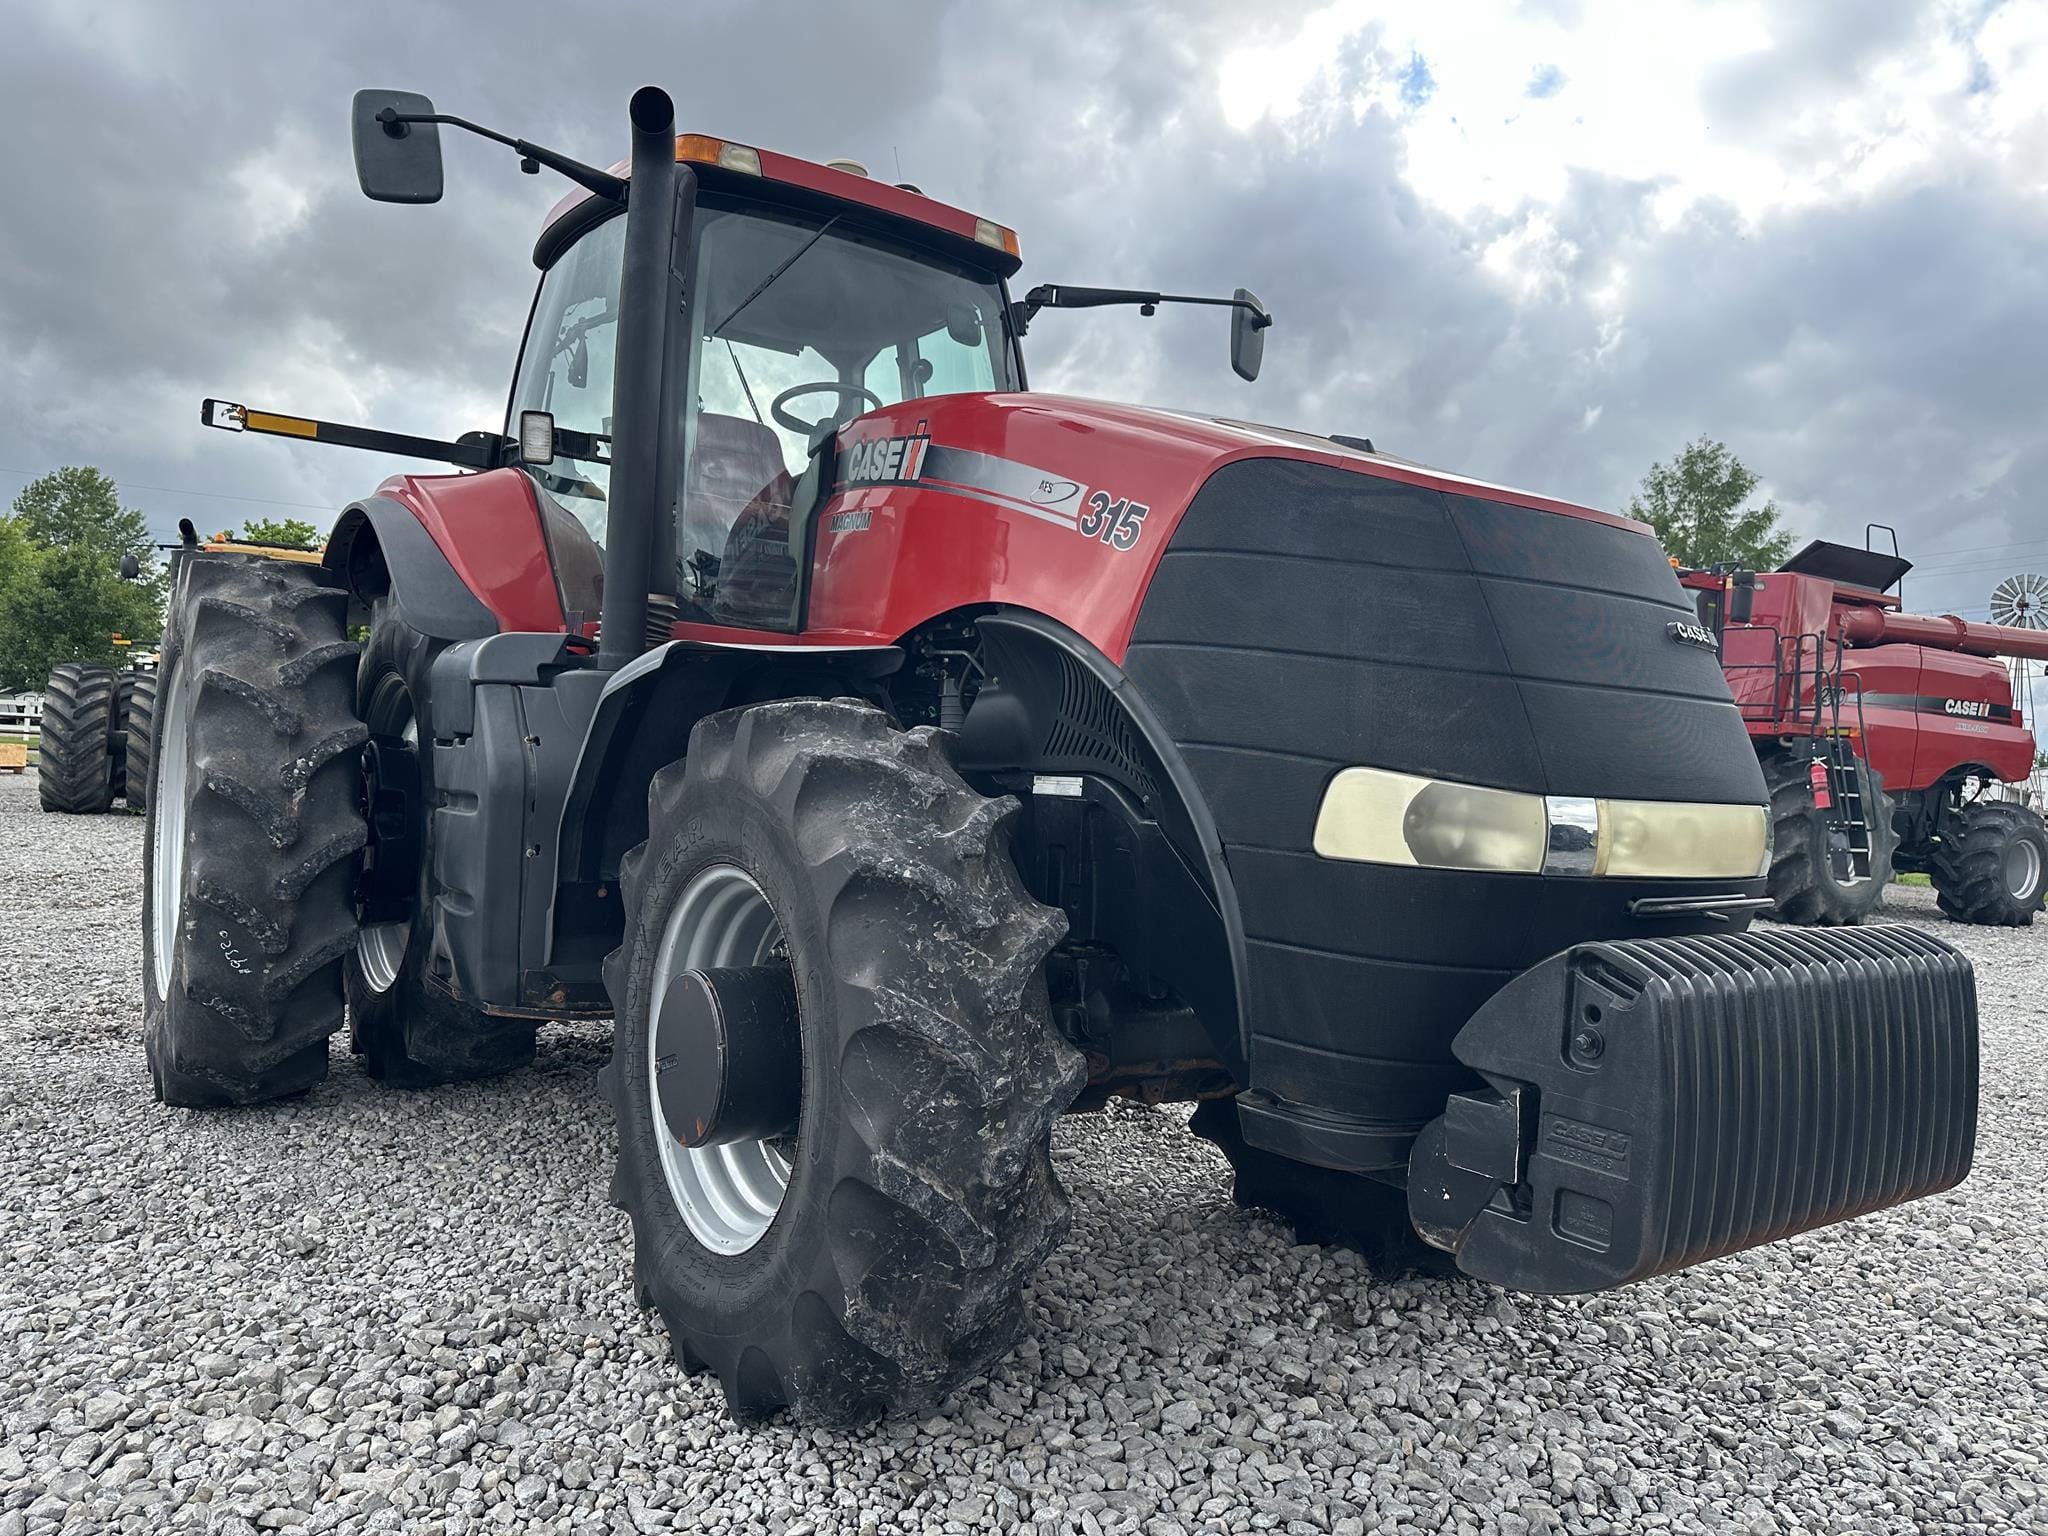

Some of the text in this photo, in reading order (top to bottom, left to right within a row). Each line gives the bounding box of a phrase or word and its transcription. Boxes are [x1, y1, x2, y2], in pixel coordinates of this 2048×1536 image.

[1038, 479, 1054, 494] AFS
[831, 511, 872, 532] MAGNUM
[1080, 490, 1150, 552] 315
